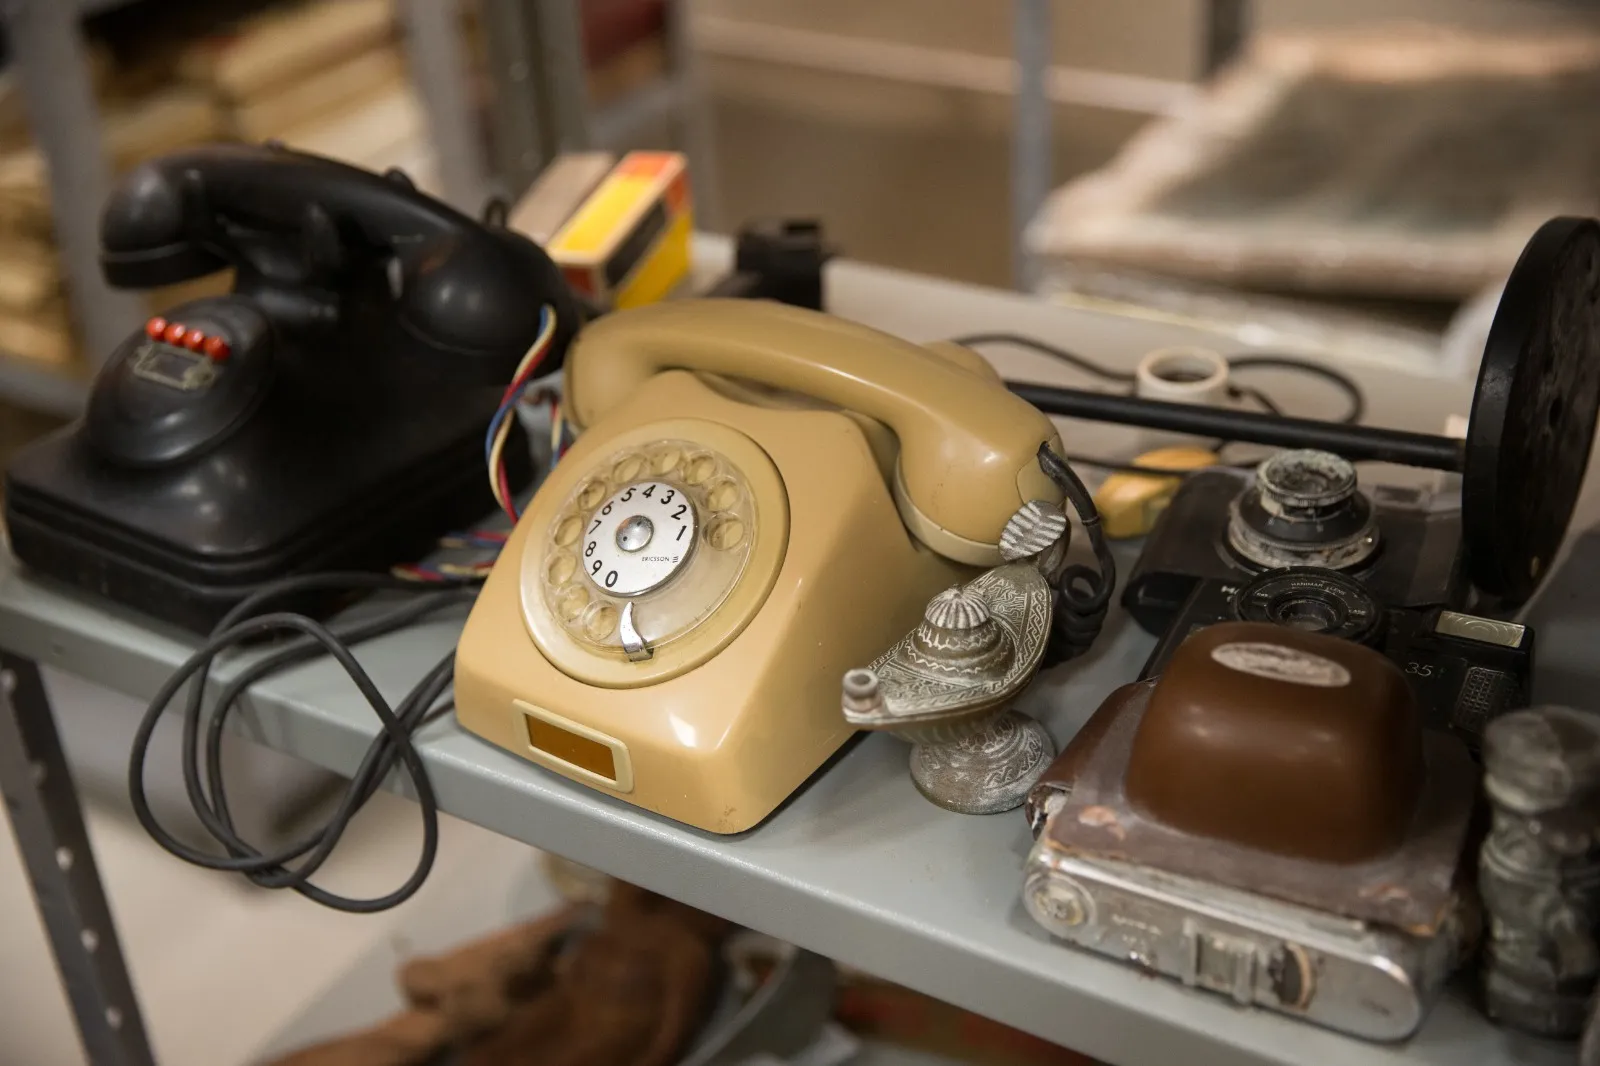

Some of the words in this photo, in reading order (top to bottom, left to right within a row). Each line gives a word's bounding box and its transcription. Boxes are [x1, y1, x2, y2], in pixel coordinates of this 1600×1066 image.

[620, 487, 637, 502] 5
[642, 484, 656, 498] 4
[660, 490, 675, 505] 3
[601, 501, 614, 515] 6
[671, 504, 687, 520] 2
[588, 519, 602, 534] 7
[676, 525, 687, 541] 1
[585, 541, 597, 557] 8
[591, 560, 603, 576] 9
[605, 570, 618, 587] 0
[1404, 661, 1433, 677] 35
